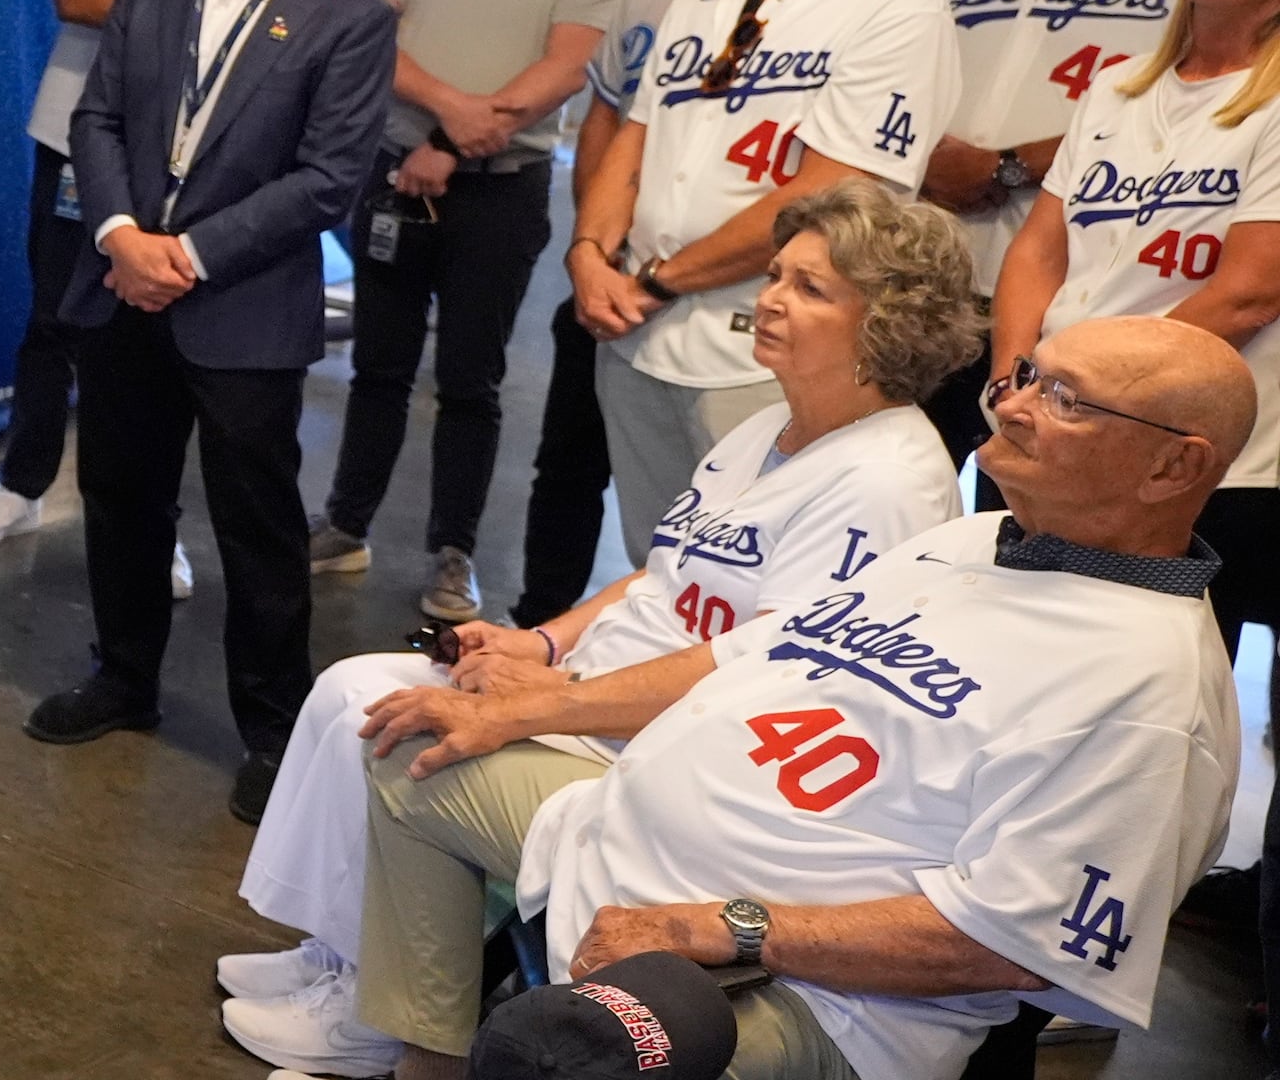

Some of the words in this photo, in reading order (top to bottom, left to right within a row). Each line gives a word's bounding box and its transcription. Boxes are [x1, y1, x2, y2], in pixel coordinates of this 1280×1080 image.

[873, 92, 917, 159] LA
[1068, 159, 1240, 227] Dodgers
[1137, 229, 1223, 281] 40
[674, 581, 736, 642] 40
[744, 707, 880, 813] 40
[1059, 863, 1133, 972] LA
[570, 981, 671, 1072] BASEBALL
